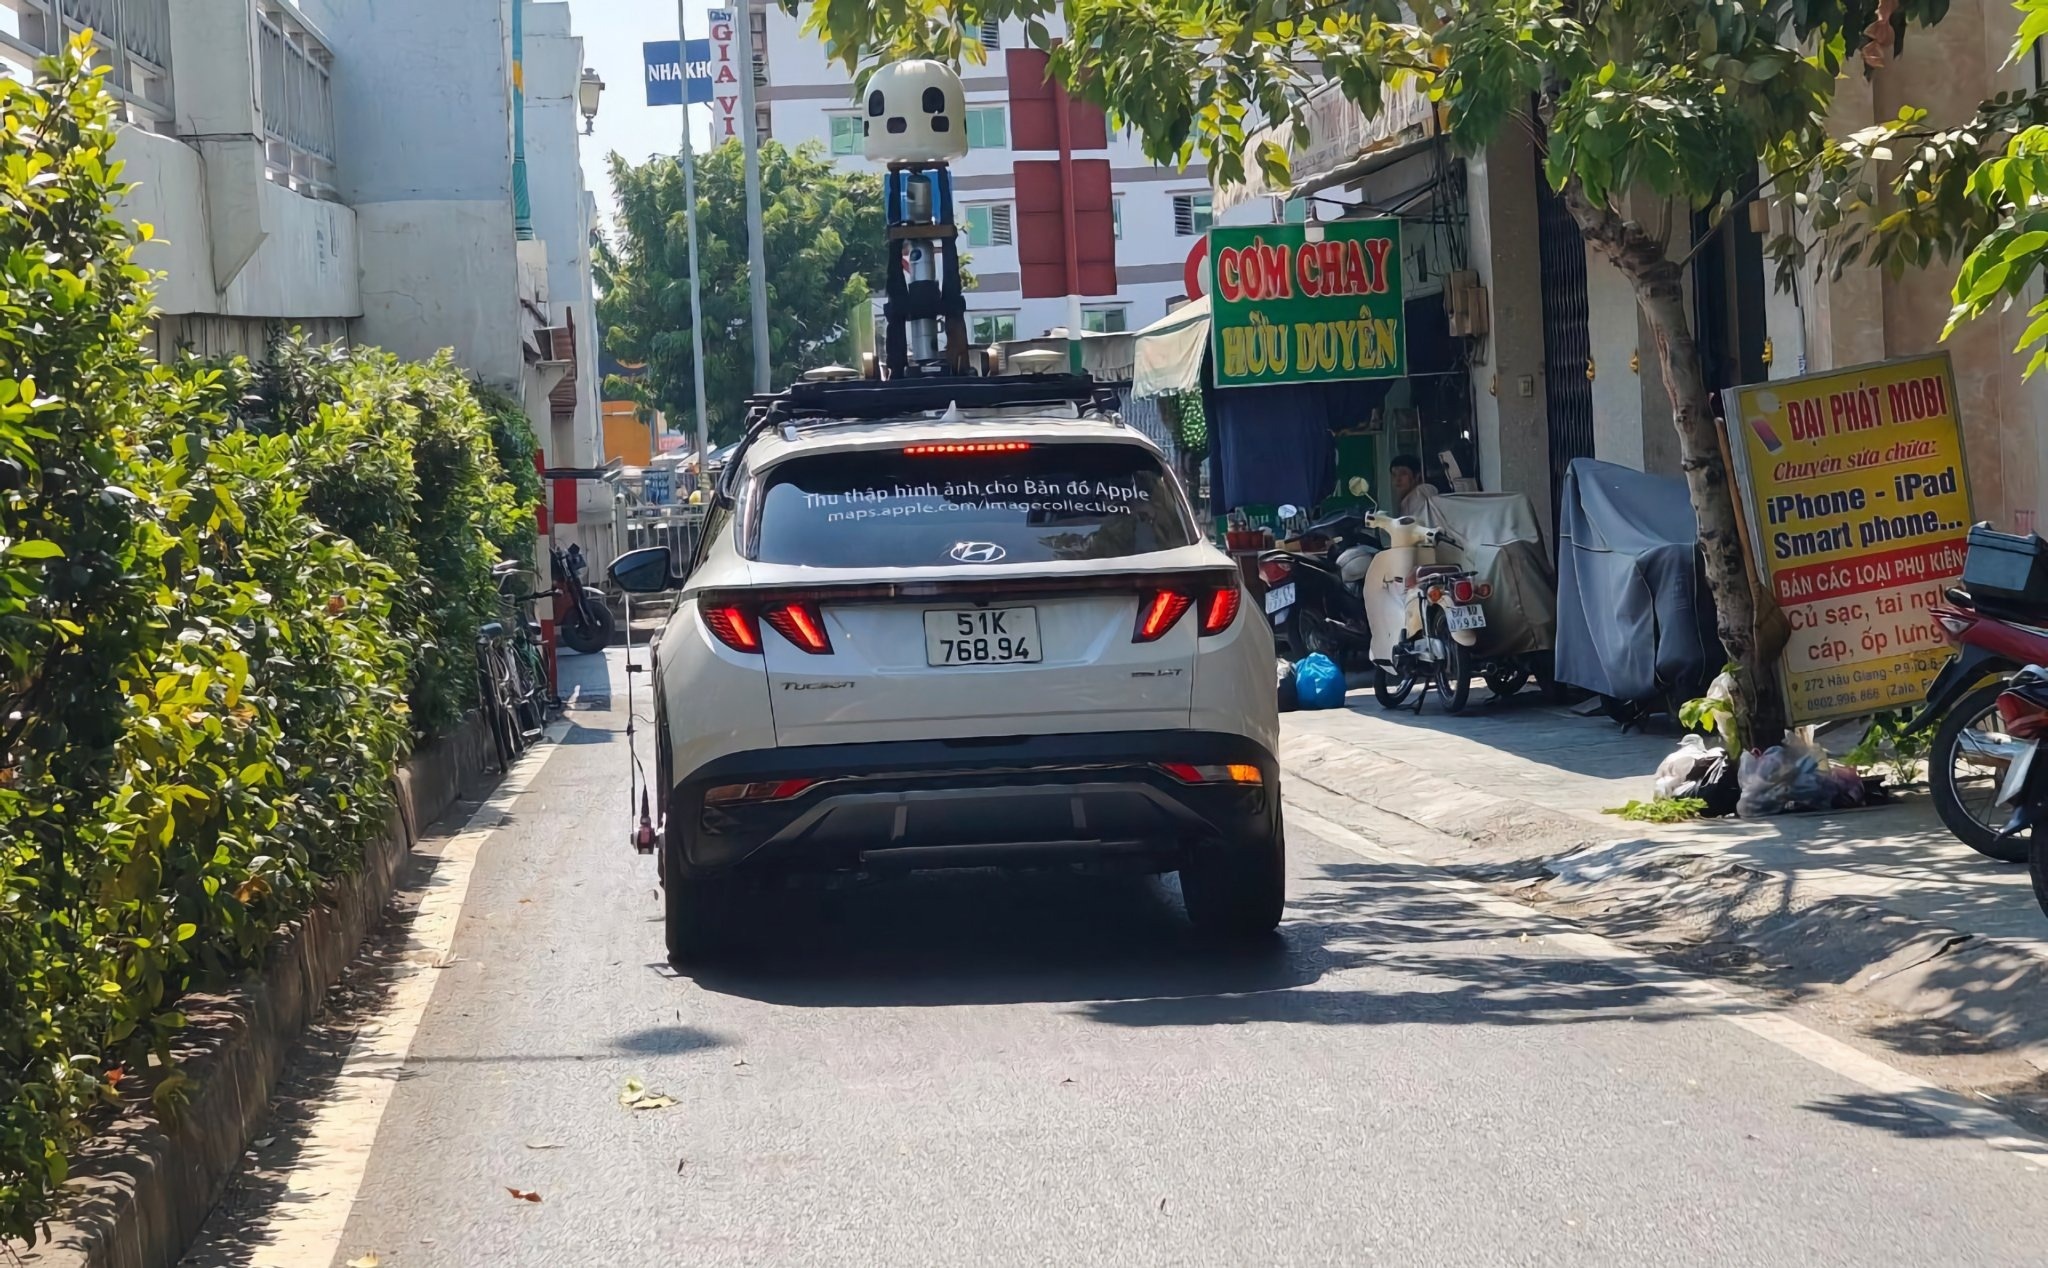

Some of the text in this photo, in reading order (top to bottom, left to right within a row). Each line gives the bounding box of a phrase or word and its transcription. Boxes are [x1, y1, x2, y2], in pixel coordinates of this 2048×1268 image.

[712, 23, 737, 84] GIA
[716, 96, 738, 140] VI
[1217, 235, 1392, 303] CƠM CHAY
[1222, 304, 1397, 377] HỮU DUYÊN
[1787, 375, 1948, 446] ĐẠI PHÁT MOBI
[1773, 453, 1842, 481] Chuyên
[806, 492, 839, 509] Thu
[895, 482, 938, 499] hình
[985, 480, 1018, 495] cho
[1024, 480, 1060, 495] Bản
[1096, 480, 1150, 502] Apple
[1766, 487, 1866, 525] iPhone
[1894, 466, 1957, 503] iPad
[1774, 509, 1963, 560] Smart phone...
[1780, 571, 1813, 598] BÁN
[1816, 565, 1851, 591] CÁC
[1856, 562, 1892, 587] LOẠI
[1894, 555, 1925, 579] PHỤ
[957, 611, 1007, 636] 51K
[1788, 584, 1950, 631] Củ sạc, tai ng
[940, 637, 1029, 662] 768.94
[1808, 622, 1944, 662] cáp, ốp lưng
